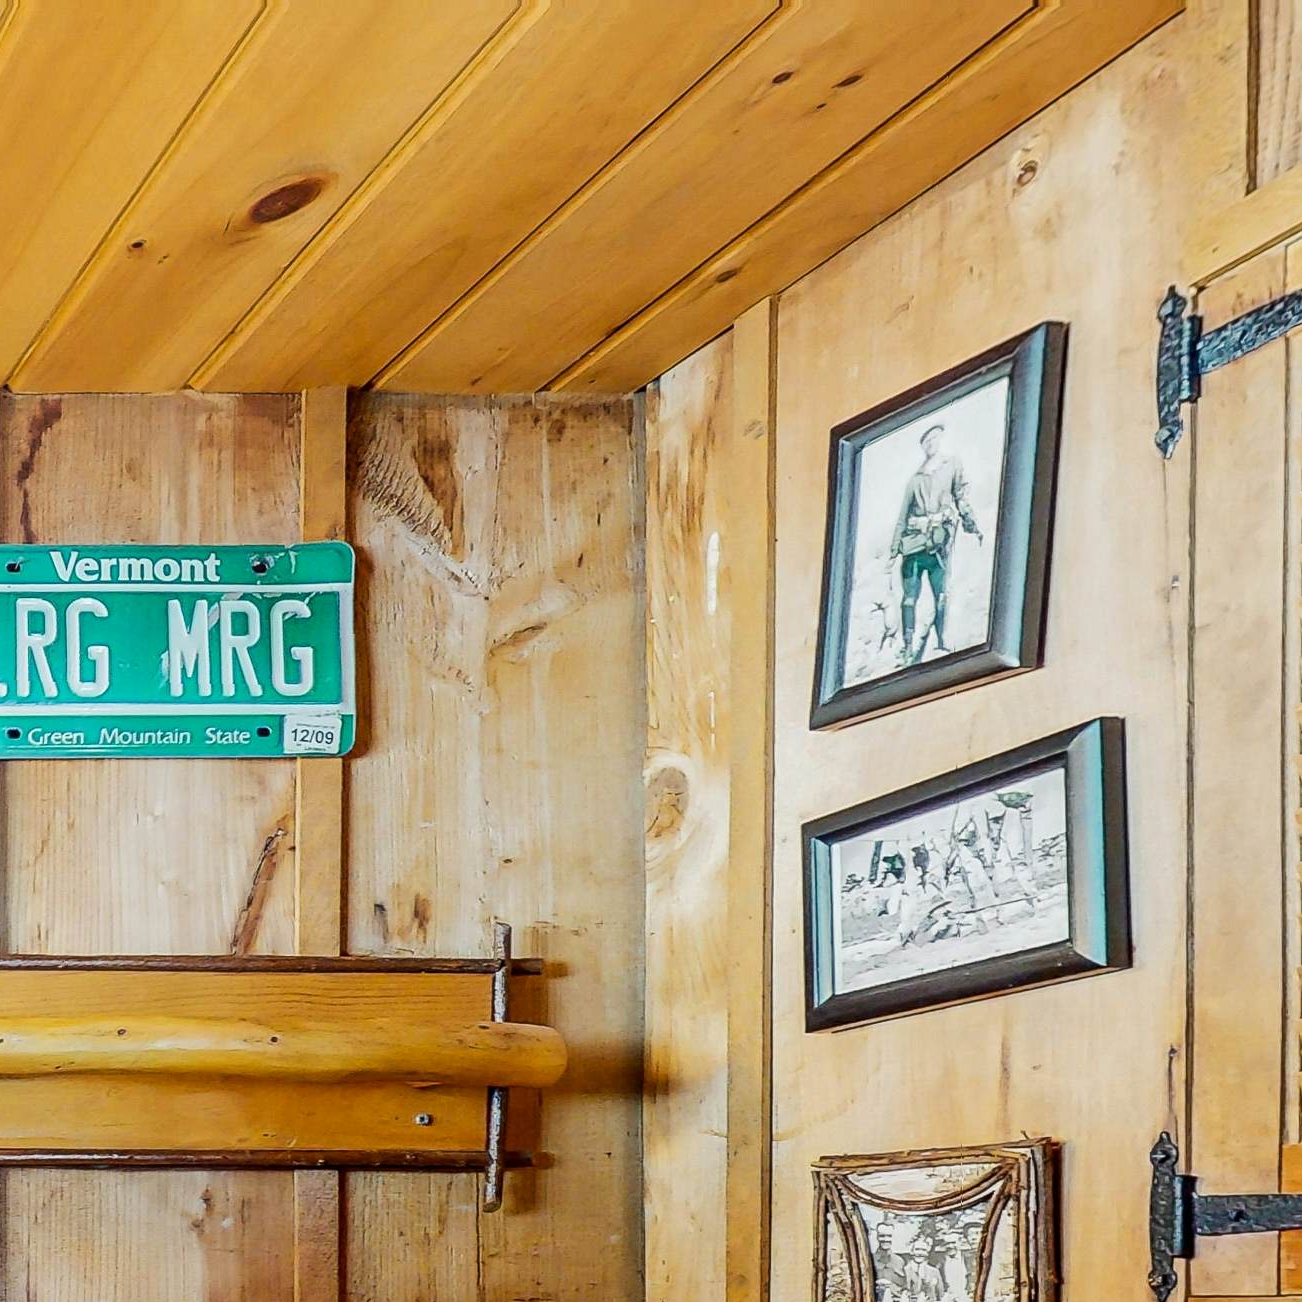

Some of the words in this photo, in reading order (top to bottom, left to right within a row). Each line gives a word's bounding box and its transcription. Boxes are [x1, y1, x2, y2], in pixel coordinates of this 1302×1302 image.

[51, 551, 221, 582] Vermont
[167, 599, 313, 697] MRG
[28, 727, 85, 746] Green
[99, 727, 191, 745] Mountain
[205, 727, 250, 745] State
[291, 728, 334, 745] 12/09
